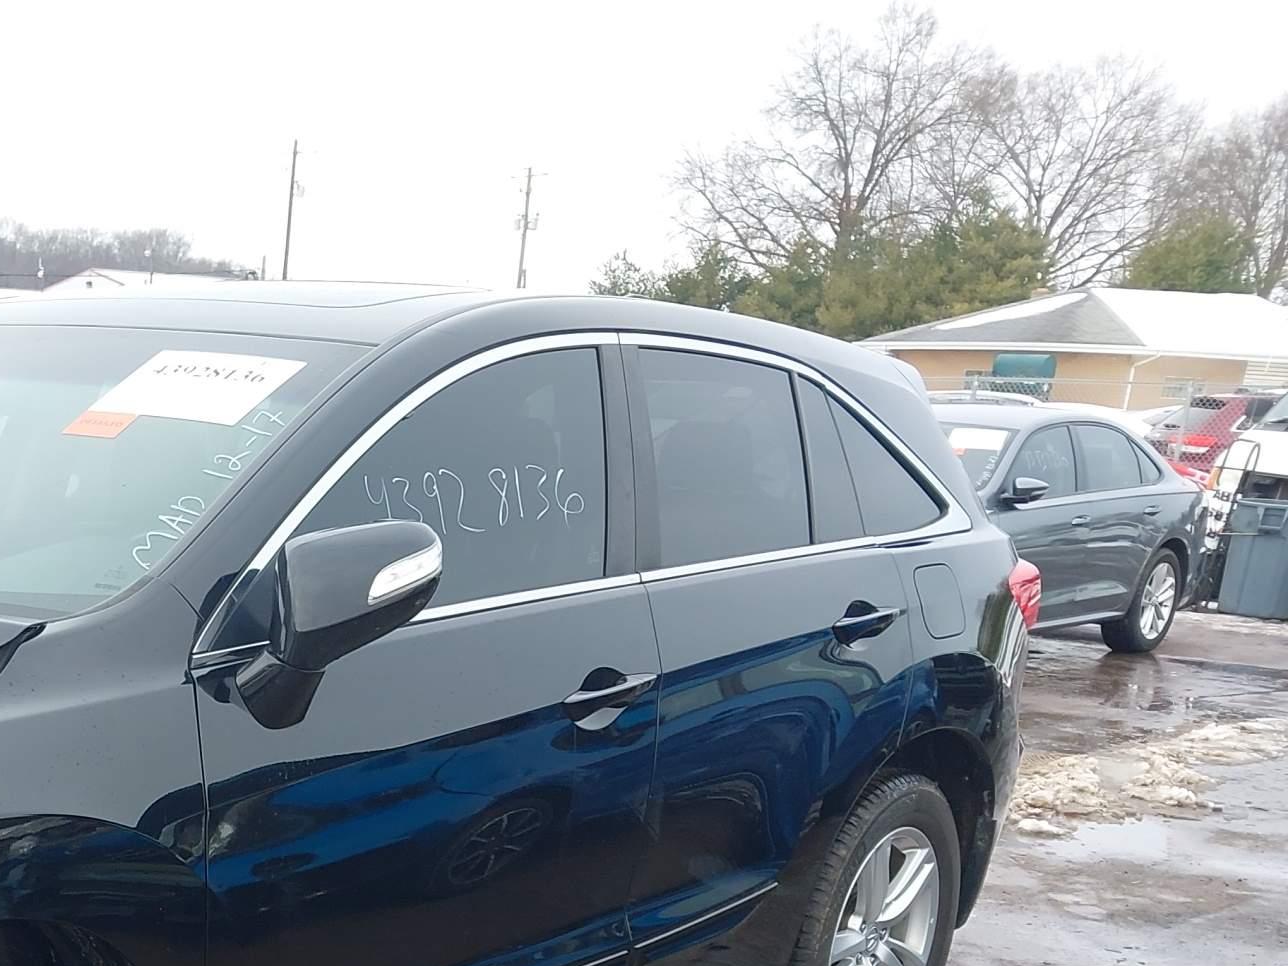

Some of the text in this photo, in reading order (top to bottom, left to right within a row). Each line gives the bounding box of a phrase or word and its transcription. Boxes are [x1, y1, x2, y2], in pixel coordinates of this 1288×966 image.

[131, 409, 286, 570] MAD 12-17
[363, 464, 585, 535] 43928136
